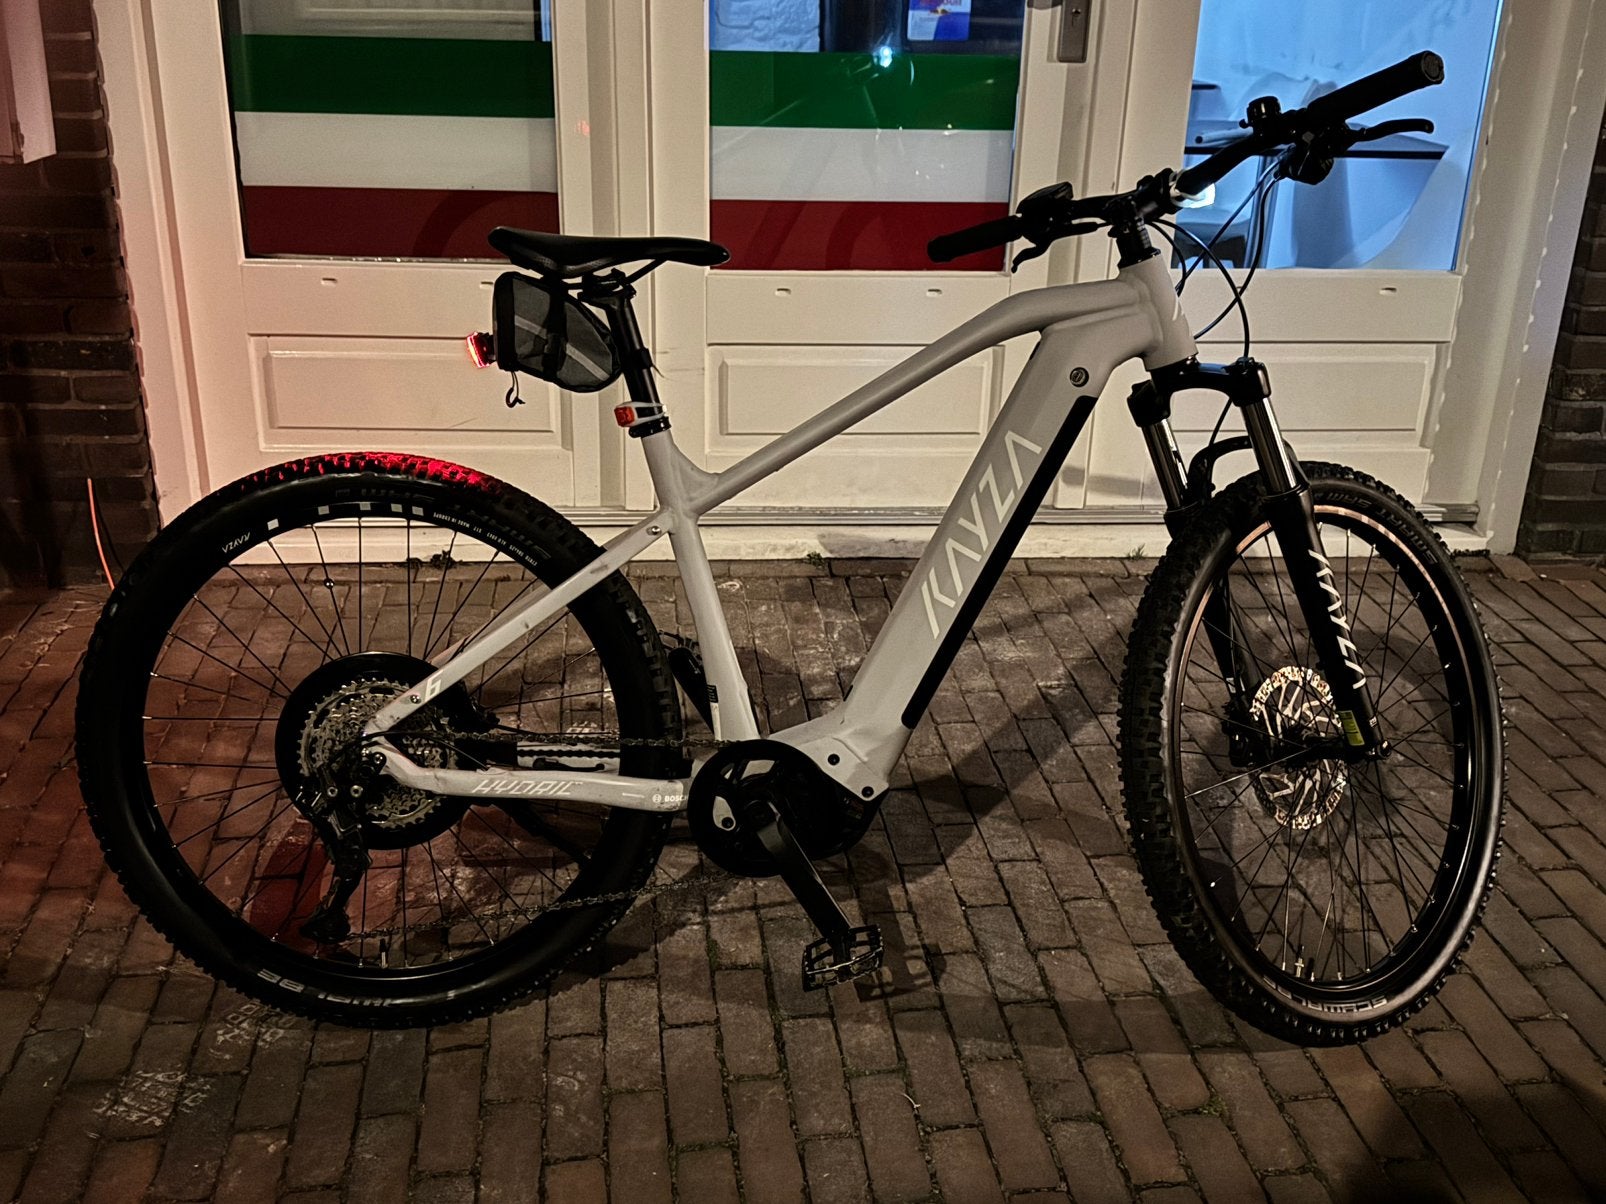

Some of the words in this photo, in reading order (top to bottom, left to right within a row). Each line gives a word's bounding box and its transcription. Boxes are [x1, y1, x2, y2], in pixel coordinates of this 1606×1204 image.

[921, 430, 1043, 640] KAYZA
[1374, 507, 1438, 564] SMART
[1308, 549, 1367, 690] KAYZA
